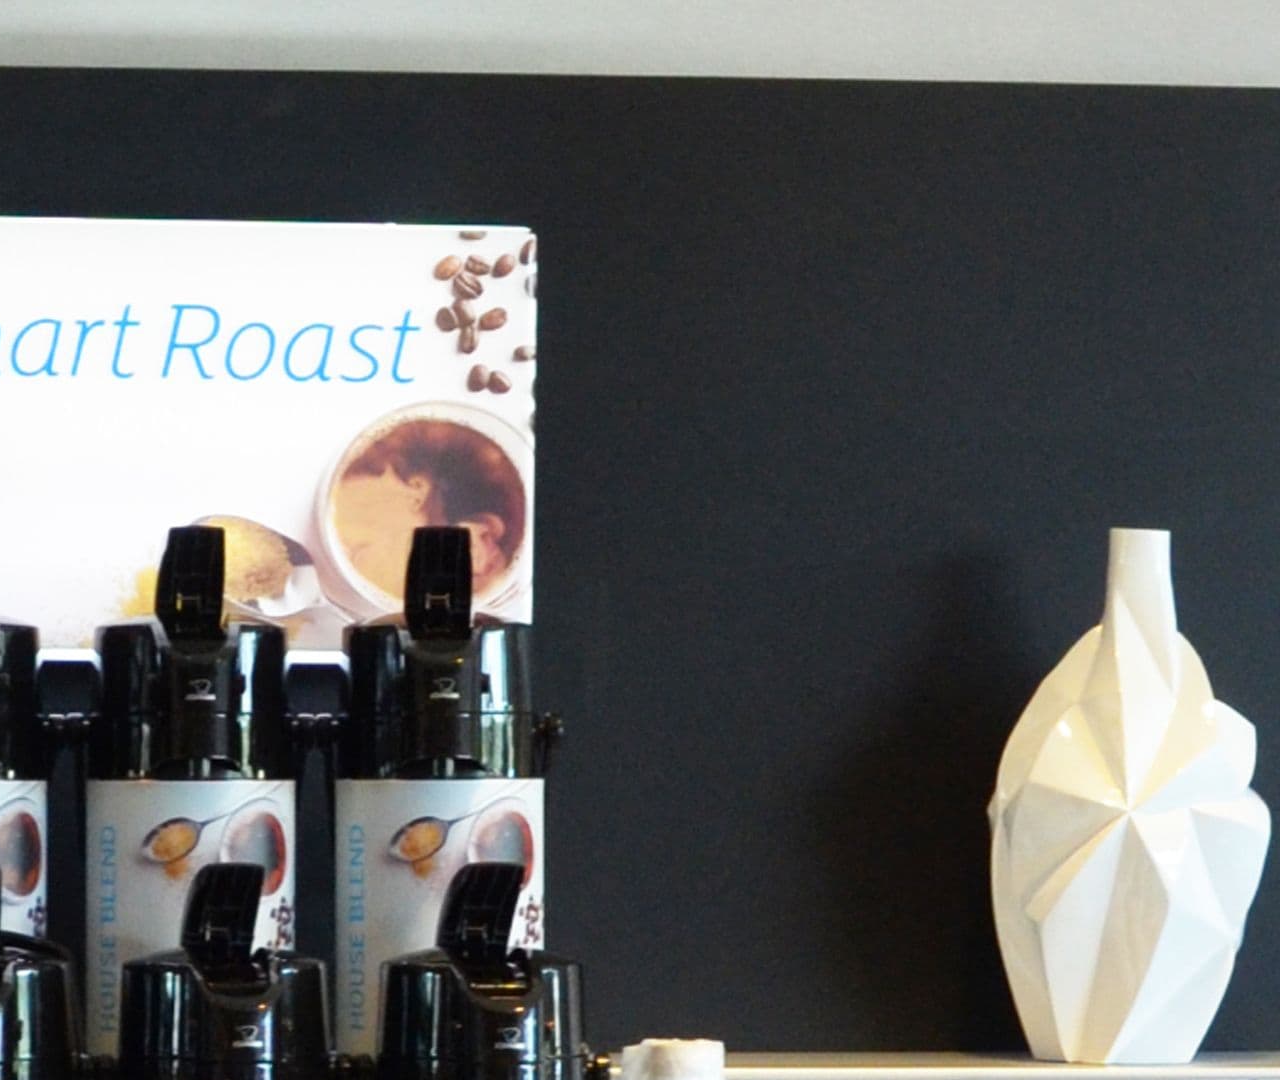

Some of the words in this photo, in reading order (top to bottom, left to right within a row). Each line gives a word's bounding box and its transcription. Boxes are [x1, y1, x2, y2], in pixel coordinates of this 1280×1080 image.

[162, 304, 420, 385] Roast
[100, 825, 115, 923] BLEND
[349, 825, 365, 923] BLEND
[100, 934, 115, 1031] HOUSE
[350, 934, 365, 1030] HOUSE
